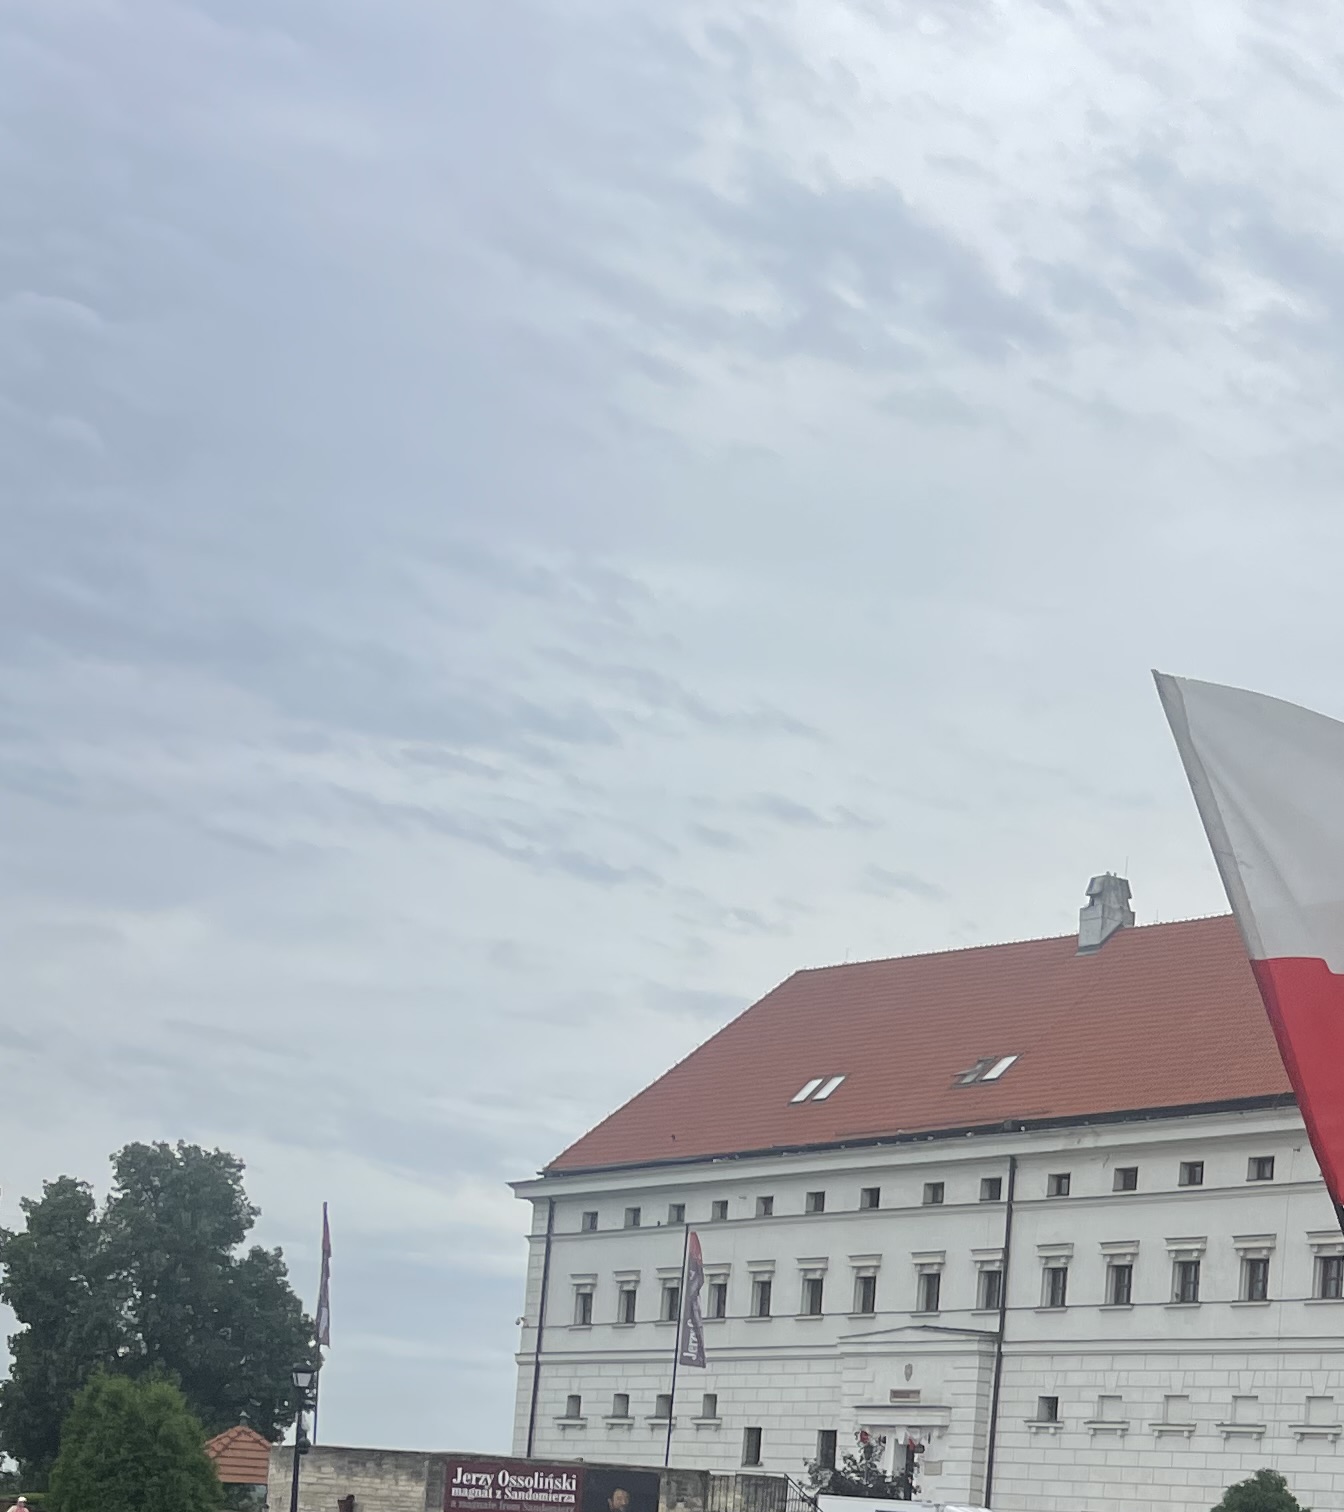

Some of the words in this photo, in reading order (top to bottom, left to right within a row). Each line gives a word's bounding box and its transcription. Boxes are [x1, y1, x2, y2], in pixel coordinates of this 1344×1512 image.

[452, 1467, 495, 1488] Jerzy
[497, 1469, 577, 1491] Ossoliński
[451, 1487, 493, 1499] magnat
[496, 1490, 502, 1499] z
[504, 1487, 576, 1503] Sandomierza
